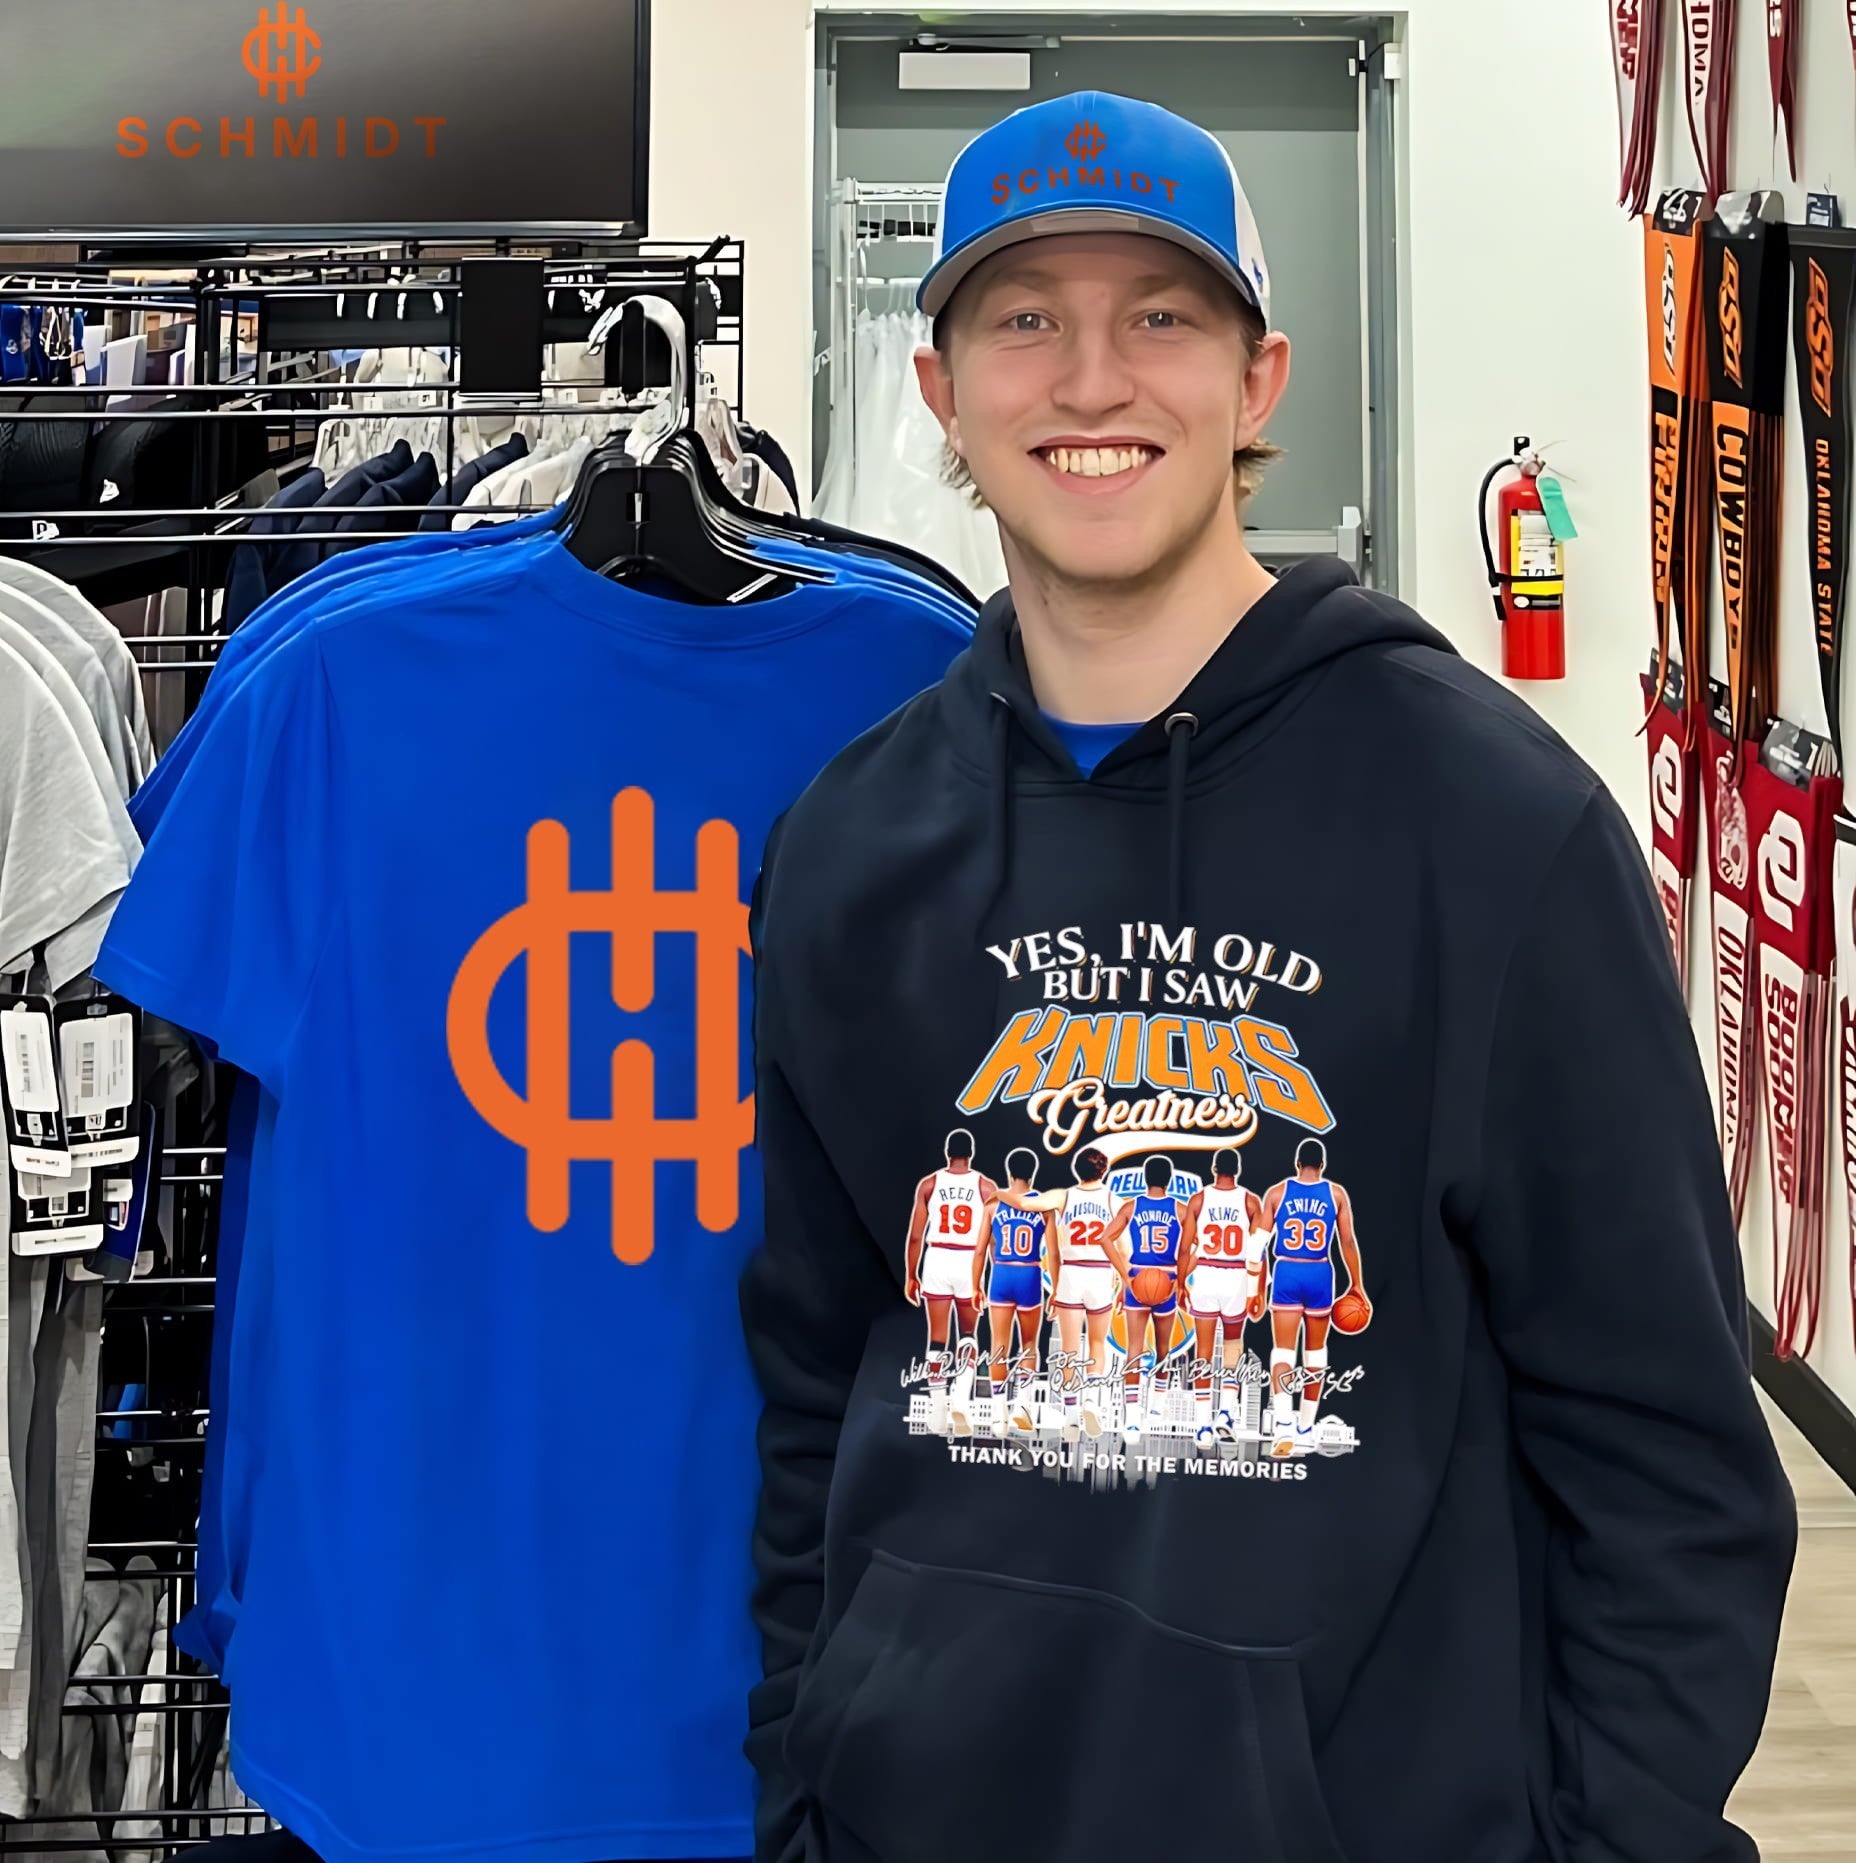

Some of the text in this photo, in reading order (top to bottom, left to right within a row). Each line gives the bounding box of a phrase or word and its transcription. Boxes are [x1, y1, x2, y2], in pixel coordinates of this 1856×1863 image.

[116, 116, 447, 158] SCHMIDT
[991, 167, 1179, 204] SCHMIDT
[1815, 439, 1833, 656] OKLAHOMA STATE
[985, 921, 1323, 995] YES, I'M OLD
[1043, 966, 1261, 1011] BUT I SAW
[955, 1004, 1337, 1135] KNICKS
[1026, 1076, 1259, 1161] Greatness
[939, 1187, 975, 1202] REED
[1284, 1198, 1328, 1217] EWING
[938, 1204, 973, 1234] 19
[994, 1208, 1046, 1228] FRAZIER
[1134, 1210, 1177, 1227] MONROE
[1208, 1207, 1240, 1222] KING
[1000, 1224, 1034, 1255] 10
[1069, 1220, 1105, 1246] 22
[1138, 1225, 1169, 1254] 15
[1203, 1224, 1243, 1256] 30
[1283, 1218, 1327, 1250] 33
[948, 1446, 1309, 1481] THANK YOU FOR THE MEMORIES
